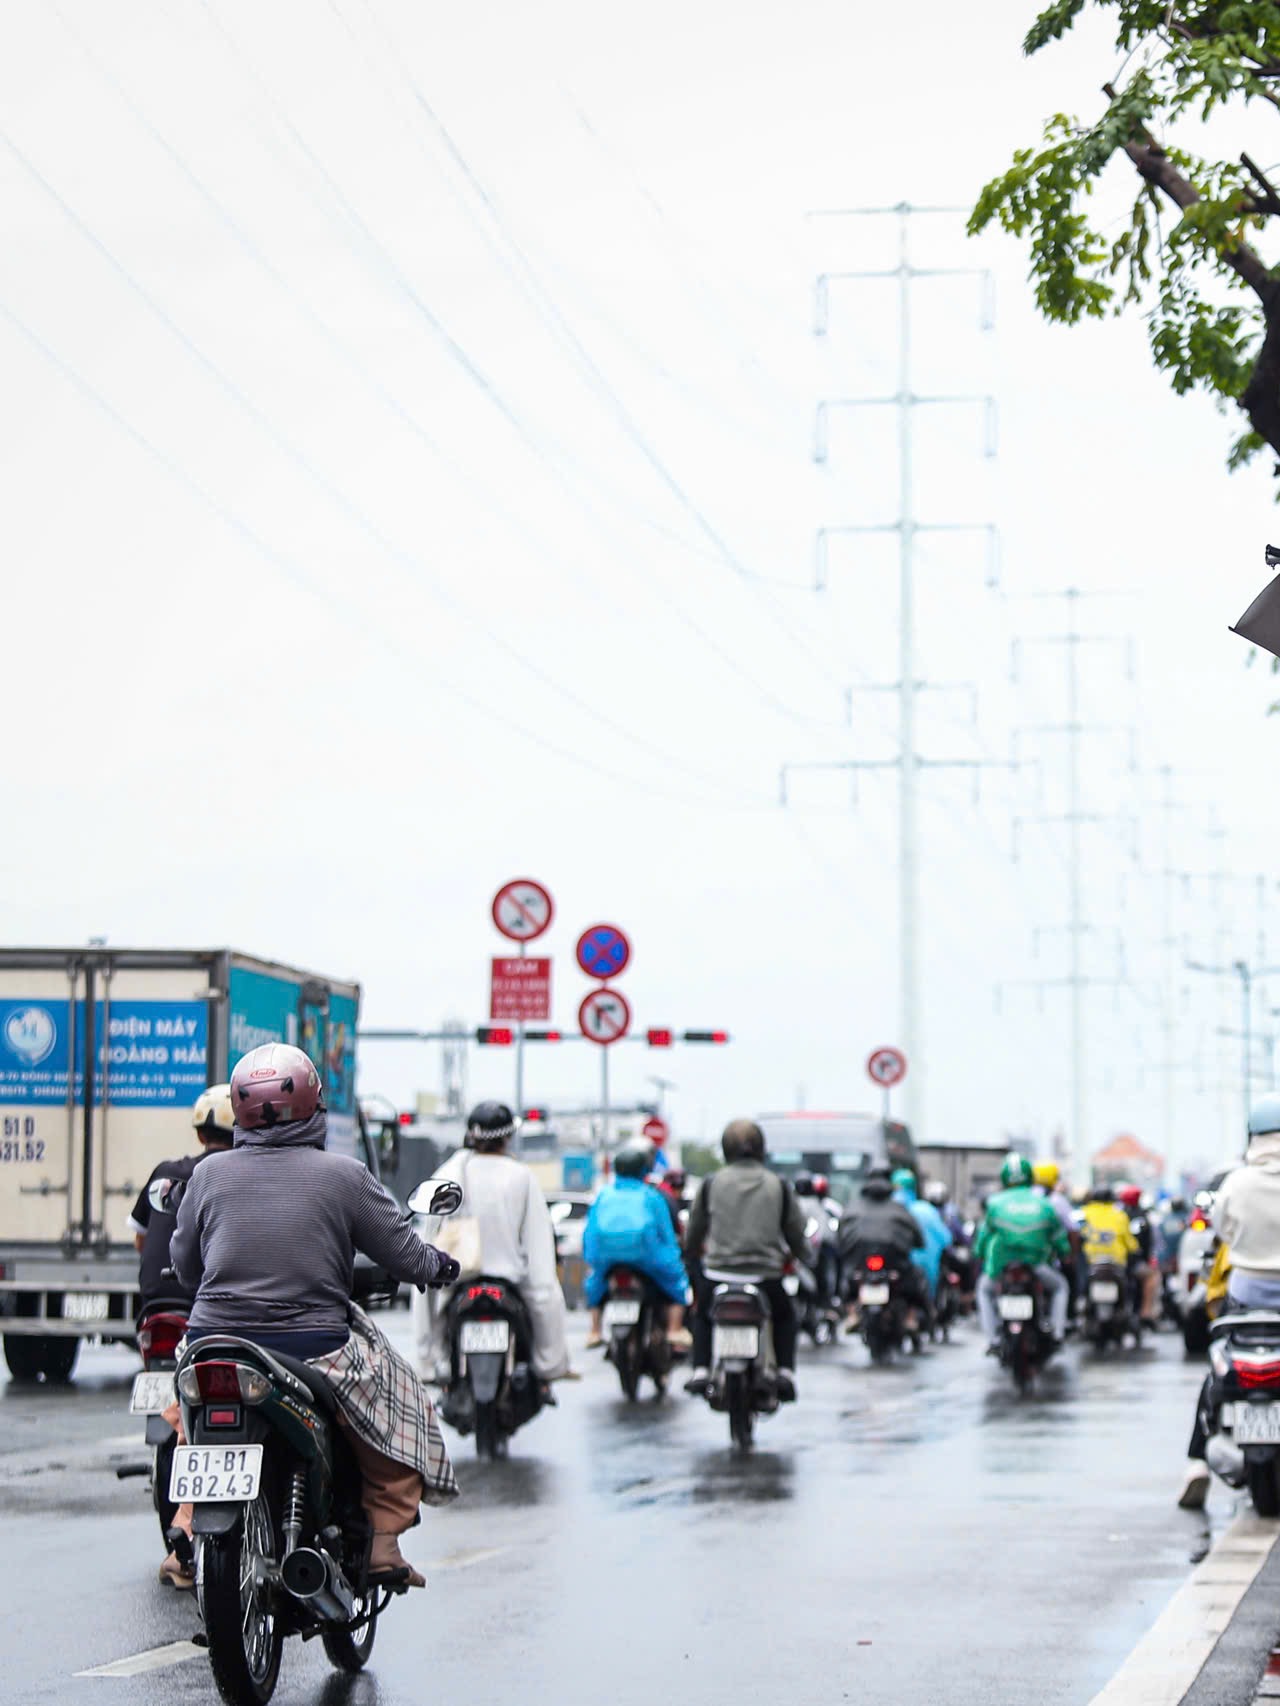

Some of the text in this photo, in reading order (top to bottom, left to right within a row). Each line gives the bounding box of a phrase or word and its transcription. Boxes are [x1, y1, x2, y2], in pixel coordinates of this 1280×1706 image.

[109, 1014, 197, 1038] ĐIỆN MÁY
[0, 1141, 45, 1161] 31.52
[188, 1451, 246, 1473] 61-B1
[176, 1474, 253, 1497] 682.43
